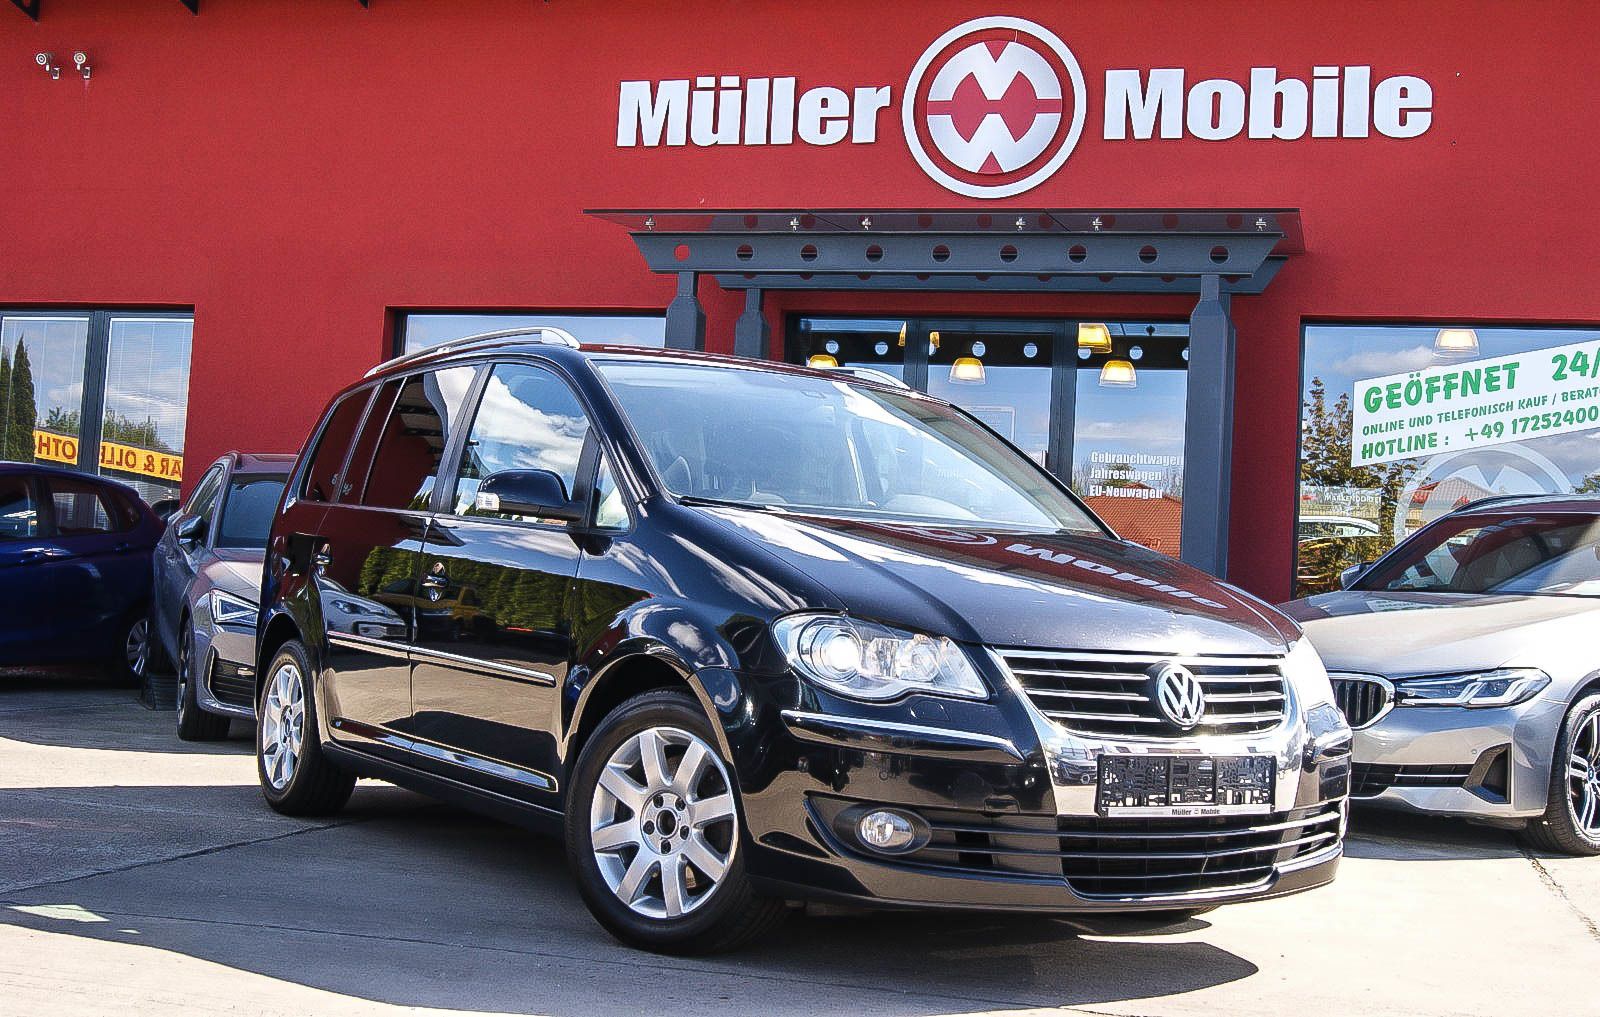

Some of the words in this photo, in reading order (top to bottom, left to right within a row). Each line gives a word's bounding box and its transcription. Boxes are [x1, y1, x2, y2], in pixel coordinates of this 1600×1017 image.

[616, 75, 891, 147] Müller
[1103, 65, 1433, 141] Mobile
[1362, 420, 1405, 436] ONLINE
[1409, 415, 1433, 428] UND
[1437, 401, 1514, 423] TELEFONISCH
[1518, 395, 1548, 410] KAUF
[1561, 386, 1600, 402] BERAT
[1364, 362, 1520, 413] GEÖFFNET
[1361, 432, 1438, 460] HOTLINE
[1465, 421, 1505, 442] +49
[1512, 405, 1599, 434] 17252400
[1089, 485, 1163, 500] EU-Neuwagen
[1090, 467, 1162, 482] Jahreswagen
[1171, 808, 1192, 816] Müller
